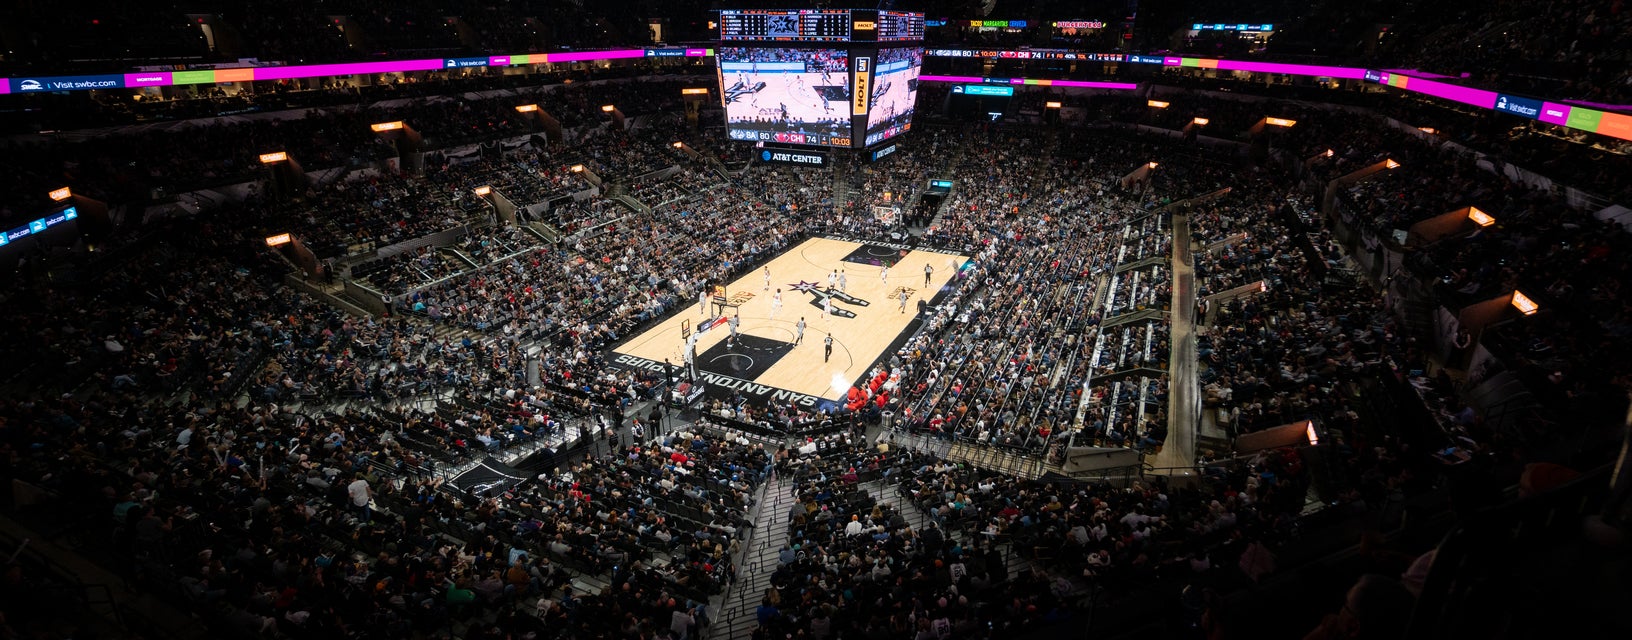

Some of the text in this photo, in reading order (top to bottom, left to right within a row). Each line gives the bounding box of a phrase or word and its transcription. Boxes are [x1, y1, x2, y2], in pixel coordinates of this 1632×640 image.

[831, 138, 850, 146] 10:03
[792, 155, 822, 164] CENTER
[46, 215, 65, 225] swbc.com
[8, 228, 30, 240] swbc.com
[852, 239, 912, 250] ANTONIO
[915, 246, 962, 256] SPURS
[687, 386, 705, 404] SPALDING
[772, 389, 818, 406] SAN
